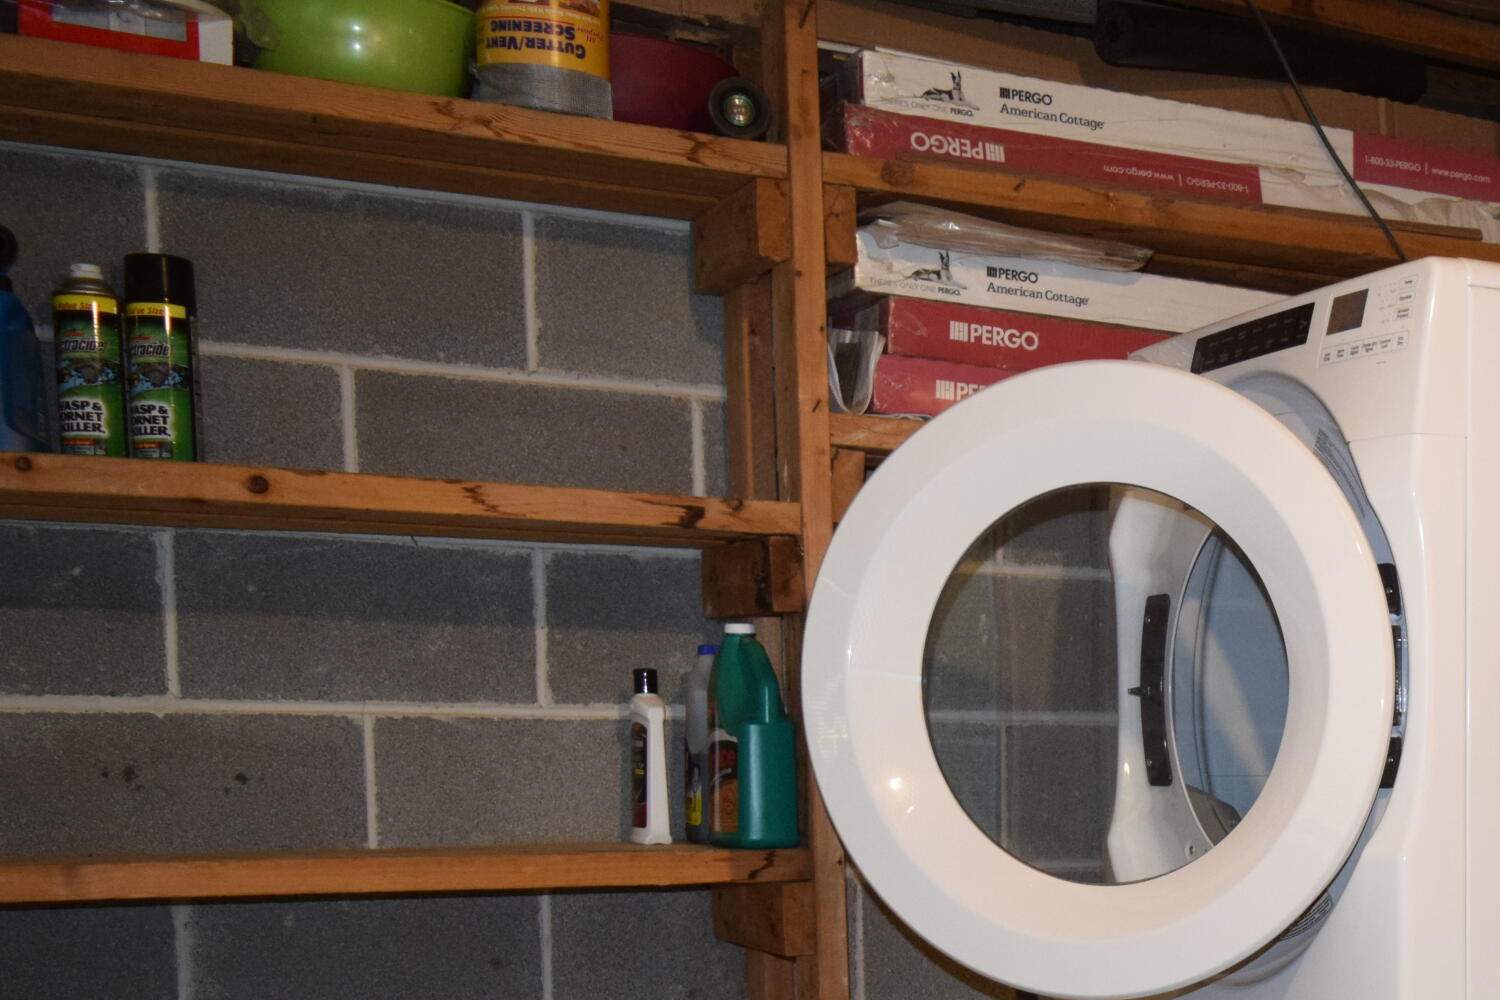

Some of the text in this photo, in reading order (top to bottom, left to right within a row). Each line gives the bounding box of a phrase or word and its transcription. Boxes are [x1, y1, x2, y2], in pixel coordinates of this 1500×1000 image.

[491, 19, 576, 40] SCREENING
[1011, 88, 1053, 106] PERGO
[1000, 104, 1104, 131] American Cottage
[911, 131, 984, 161] PERGO
[1104, 165, 1175, 182] www.pergo.com
[1364, 155, 1492, 183] 1-800-33-PERGO www.pergo.com
[998, 266, 1039, 284] PERGO
[987, 282, 1089, 307] American Cottage
[970, 323, 1039, 351] PERGO
[59, 411, 104, 422] ORNET
[131, 414, 170, 426] ORNET
